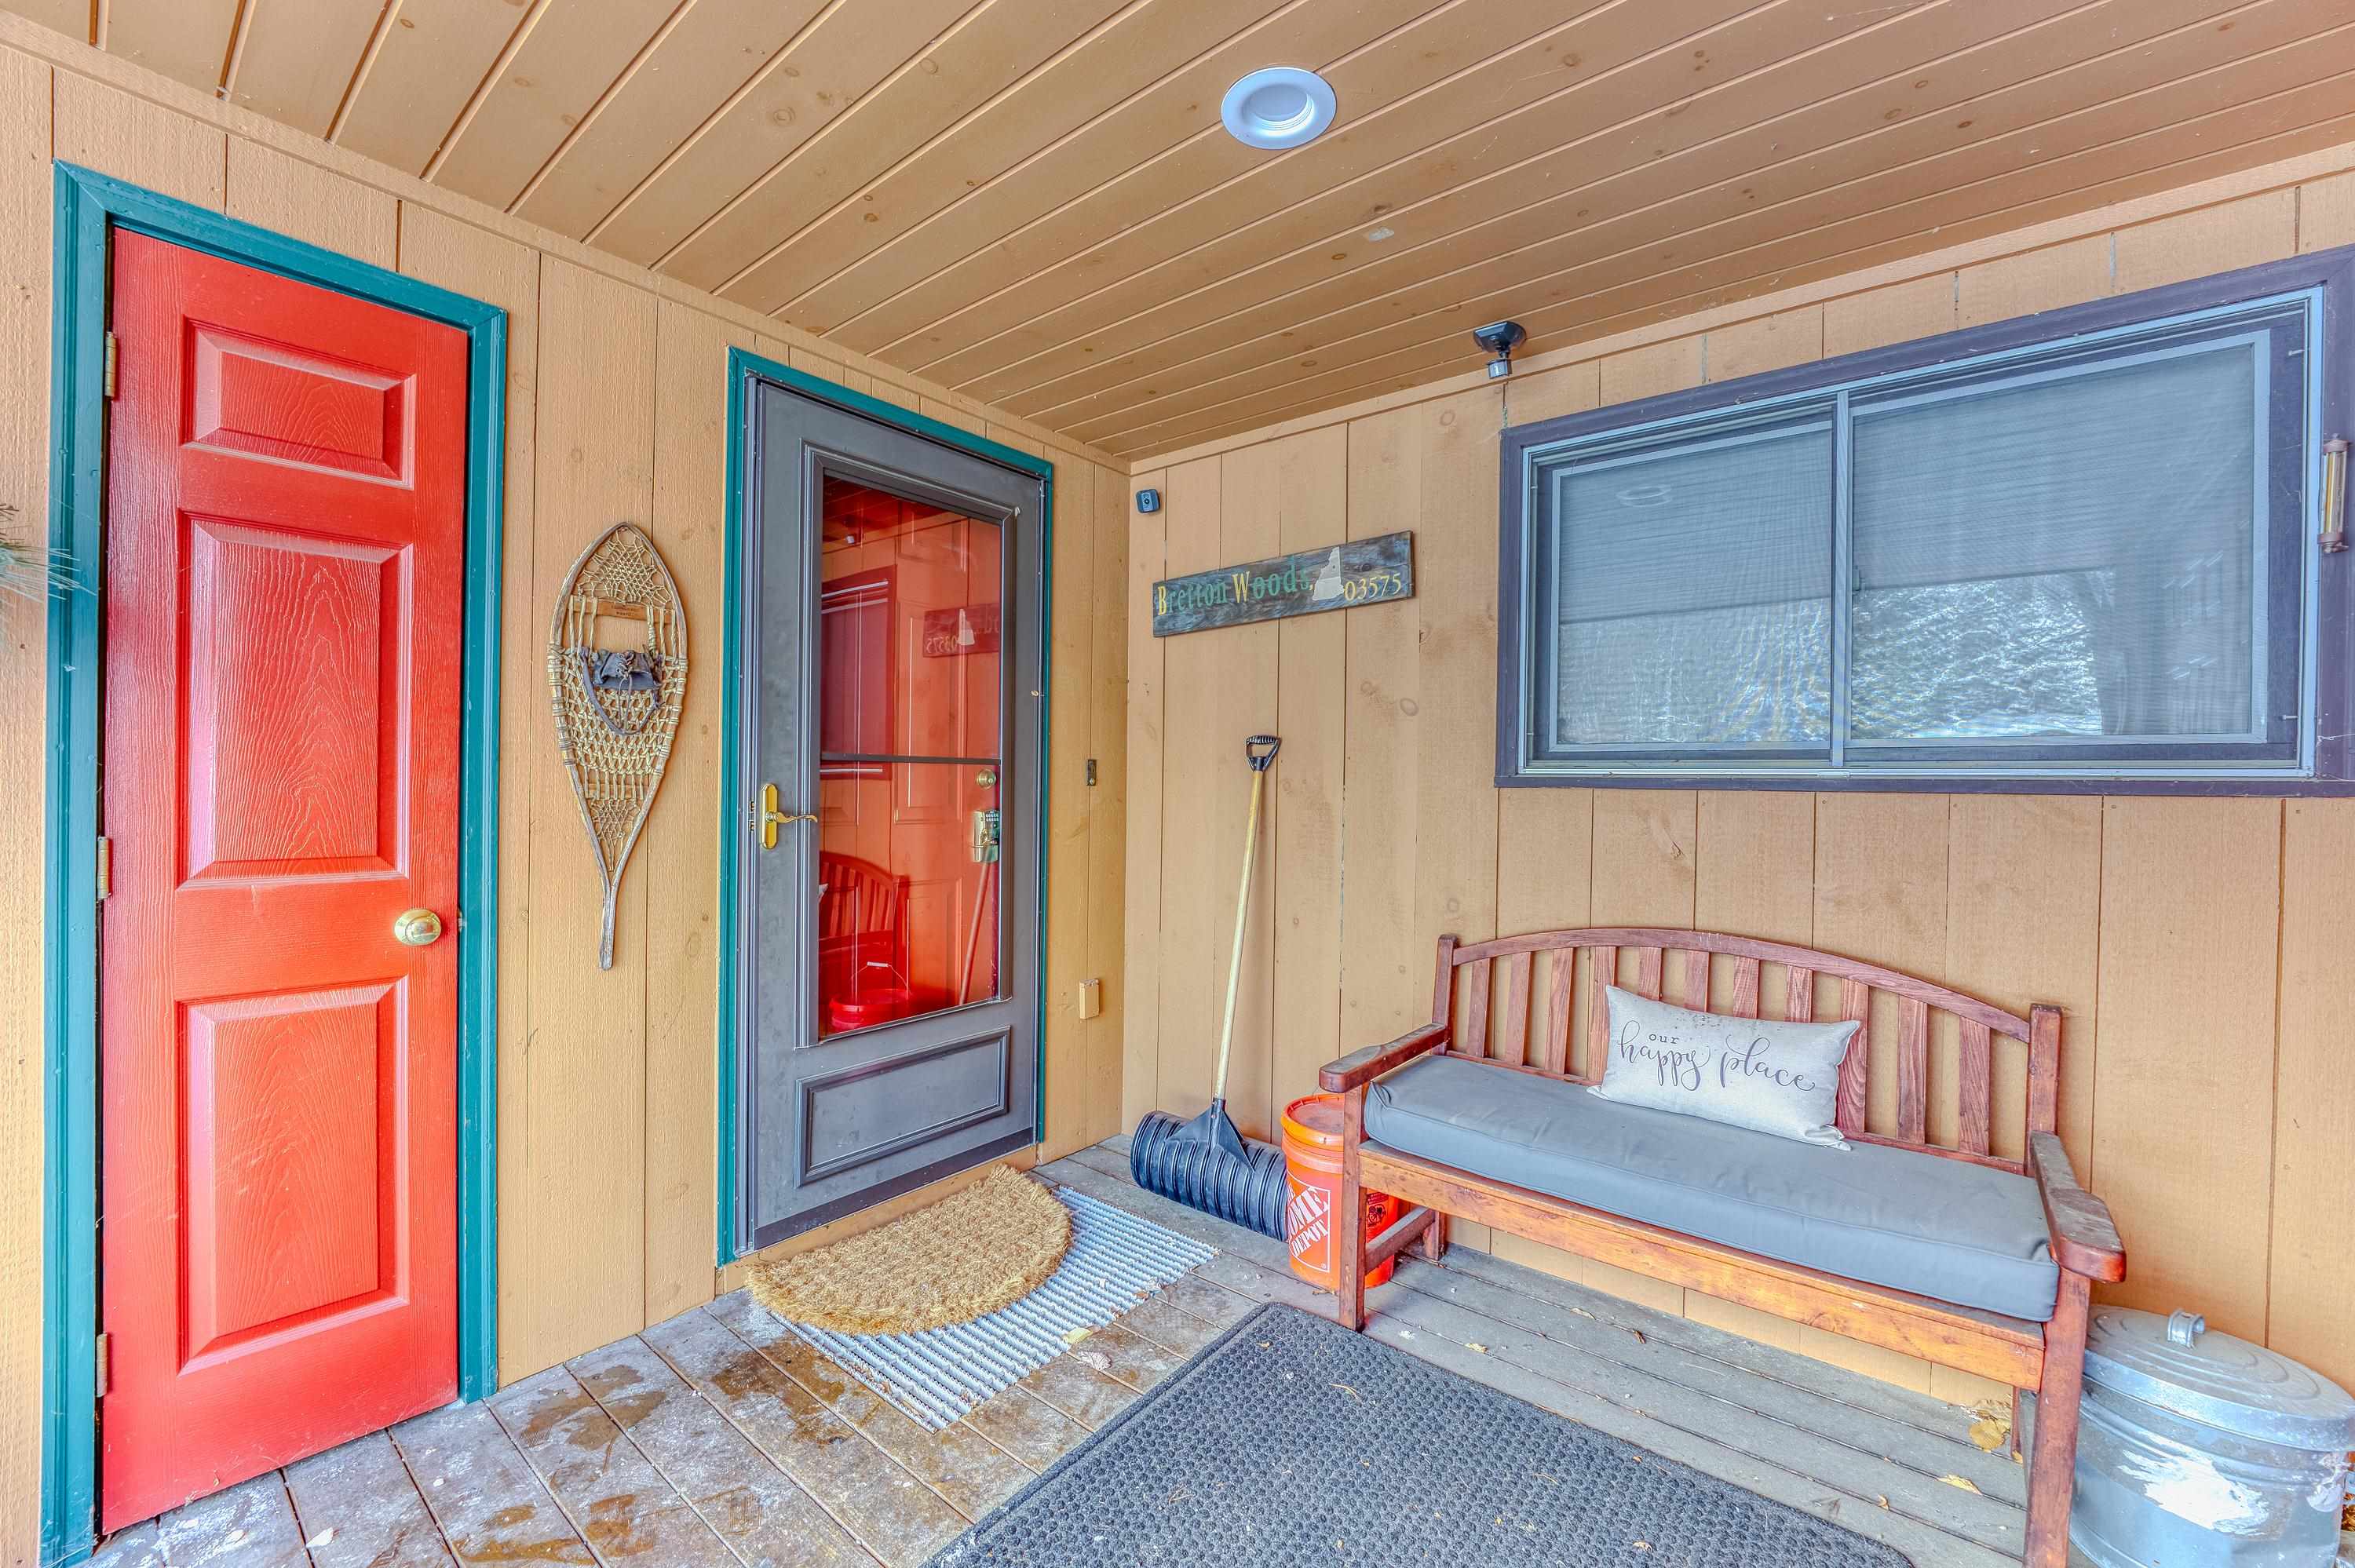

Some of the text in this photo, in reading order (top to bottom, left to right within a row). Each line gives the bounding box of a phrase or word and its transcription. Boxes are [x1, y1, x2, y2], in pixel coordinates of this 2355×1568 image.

[1158, 580, 1228, 615] Bretton
[1344, 573, 1401, 601] 03575
[1619, 1020, 1815, 1091] happy place
[1649, 1034, 1679, 1045] our
[1288, 1187, 1328, 1240] OME
[1291, 1219, 1328, 1257] DEPOT
